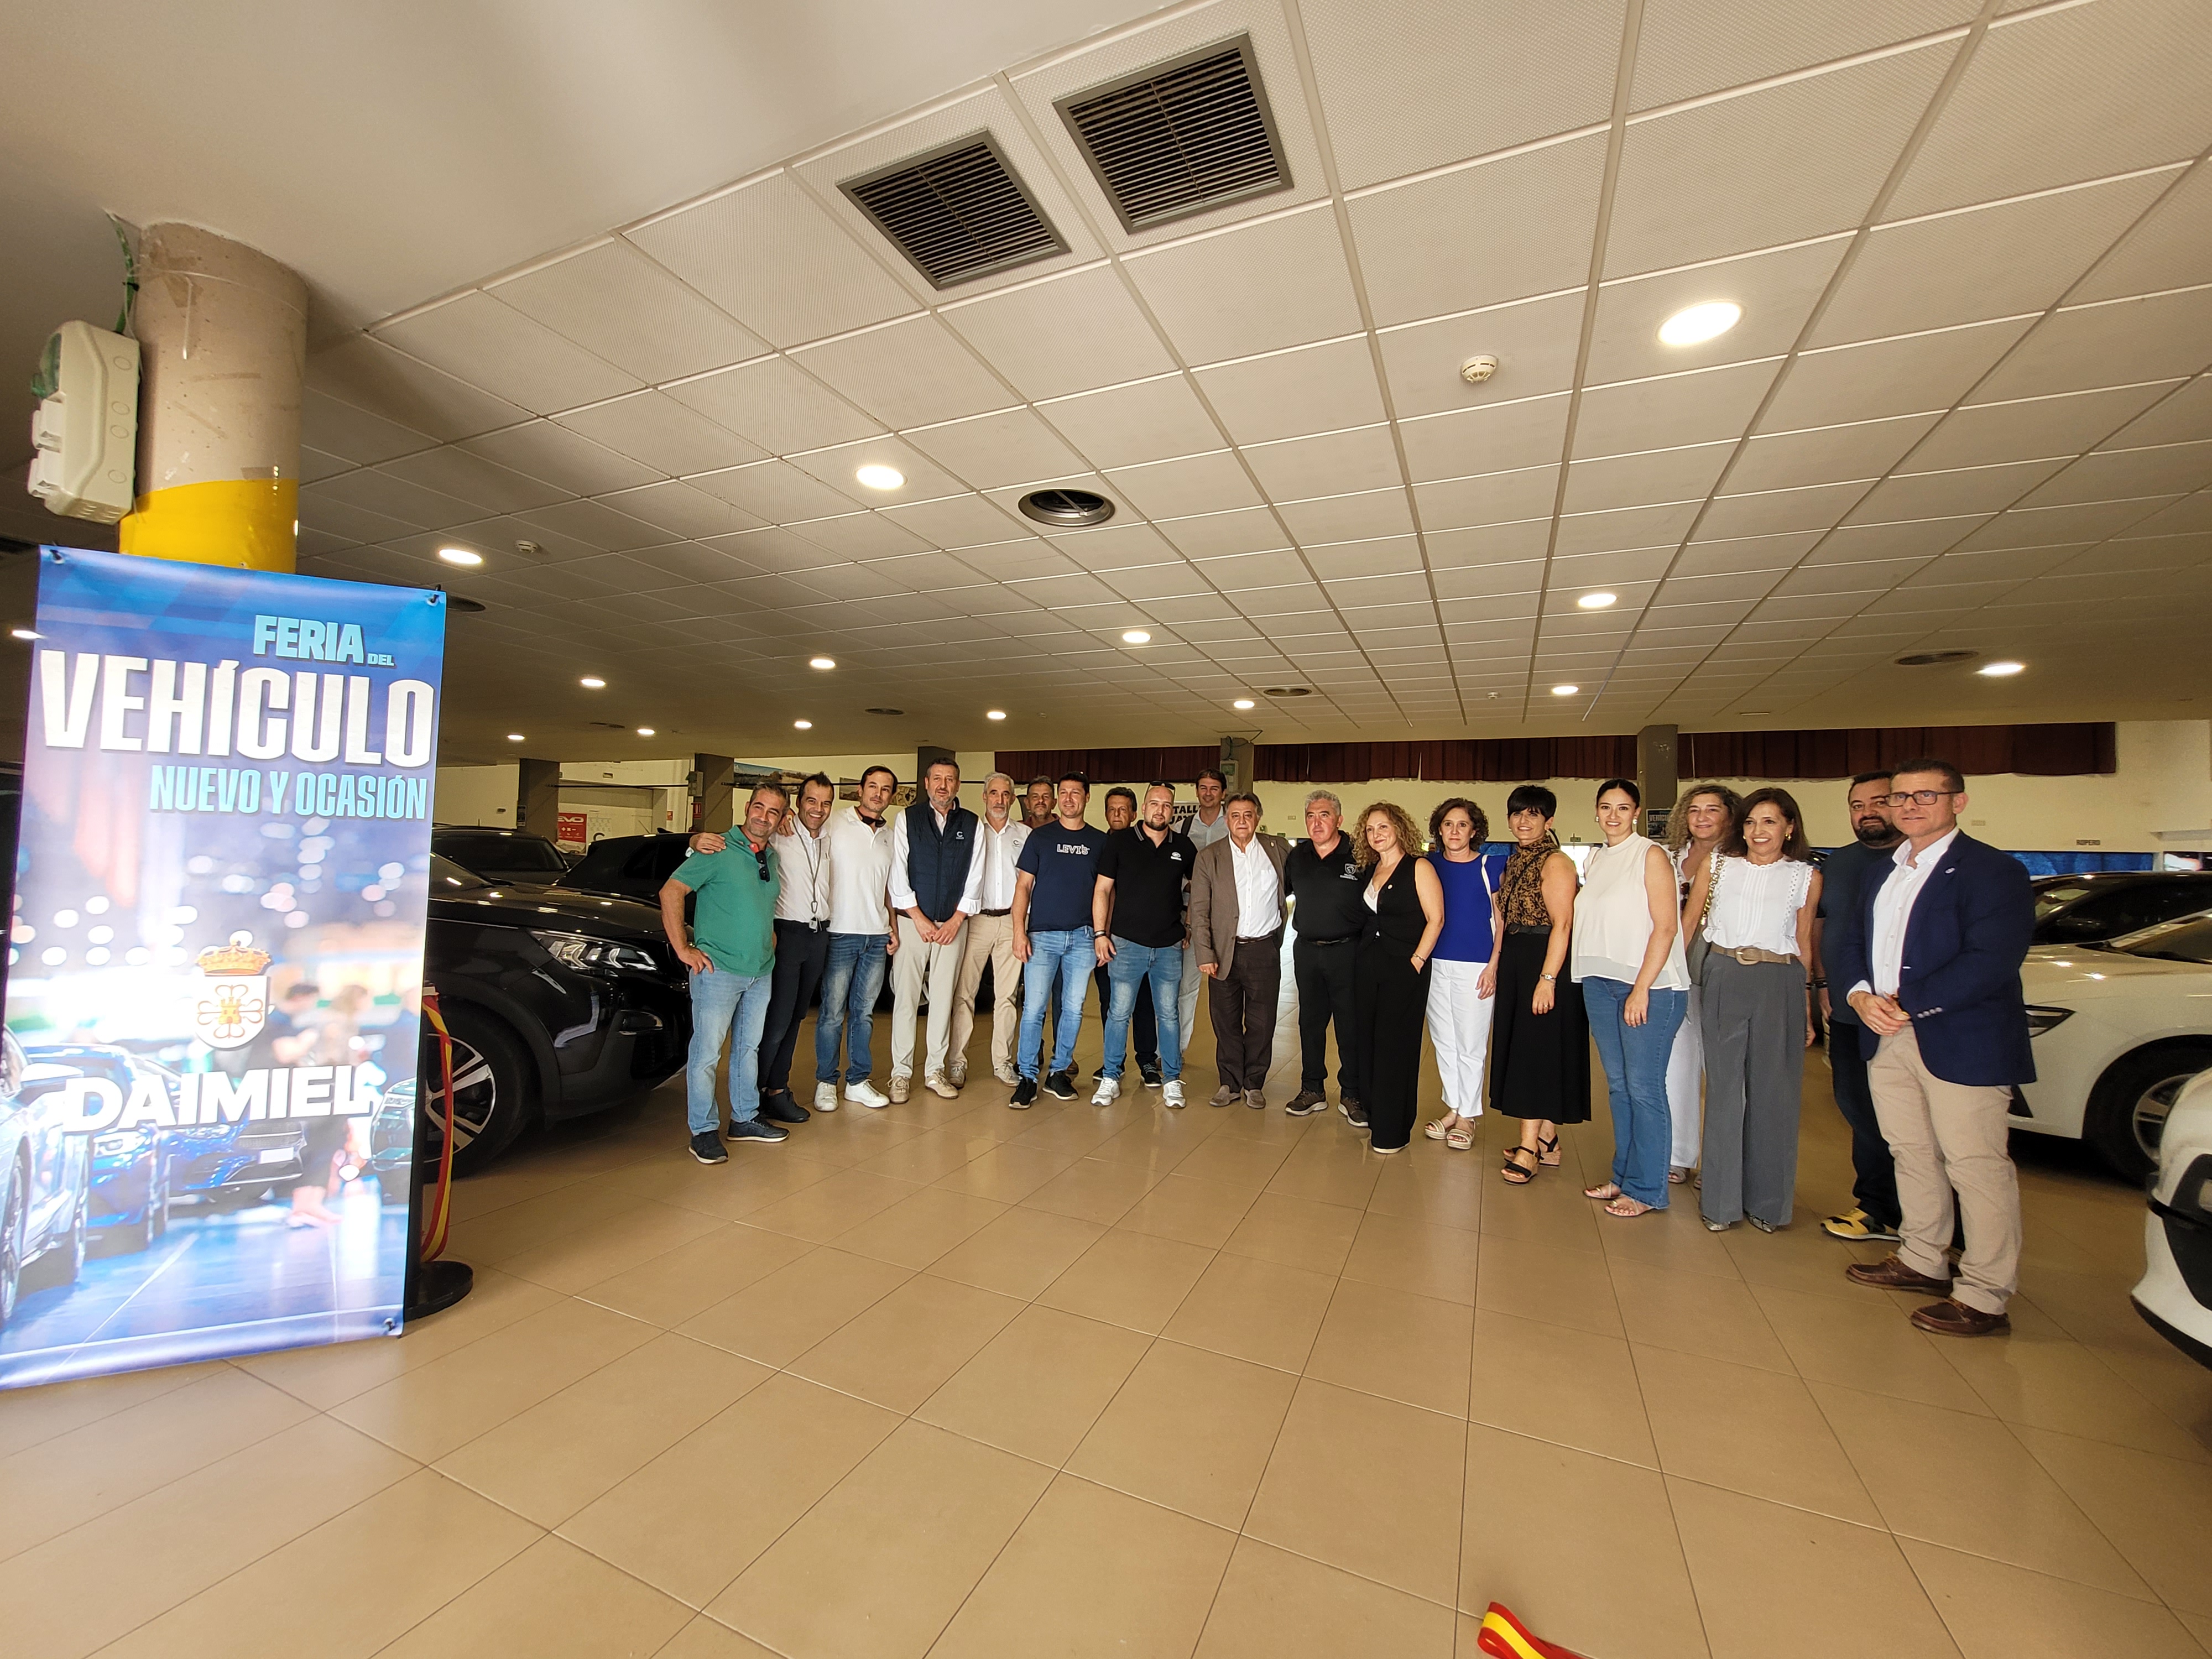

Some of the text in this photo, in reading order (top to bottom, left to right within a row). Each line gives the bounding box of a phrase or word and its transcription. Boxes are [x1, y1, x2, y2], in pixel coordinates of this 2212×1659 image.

[253, 614, 395, 666] FERIA DEL
[40, 649, 435, 768] VEHÍCULO
[149, 765, 427, 820] NUEVO Y OCASIÓN
[1173, 805, 1201, 814] TALL
[62, 1065, 373, 1133] DAIMIEL
